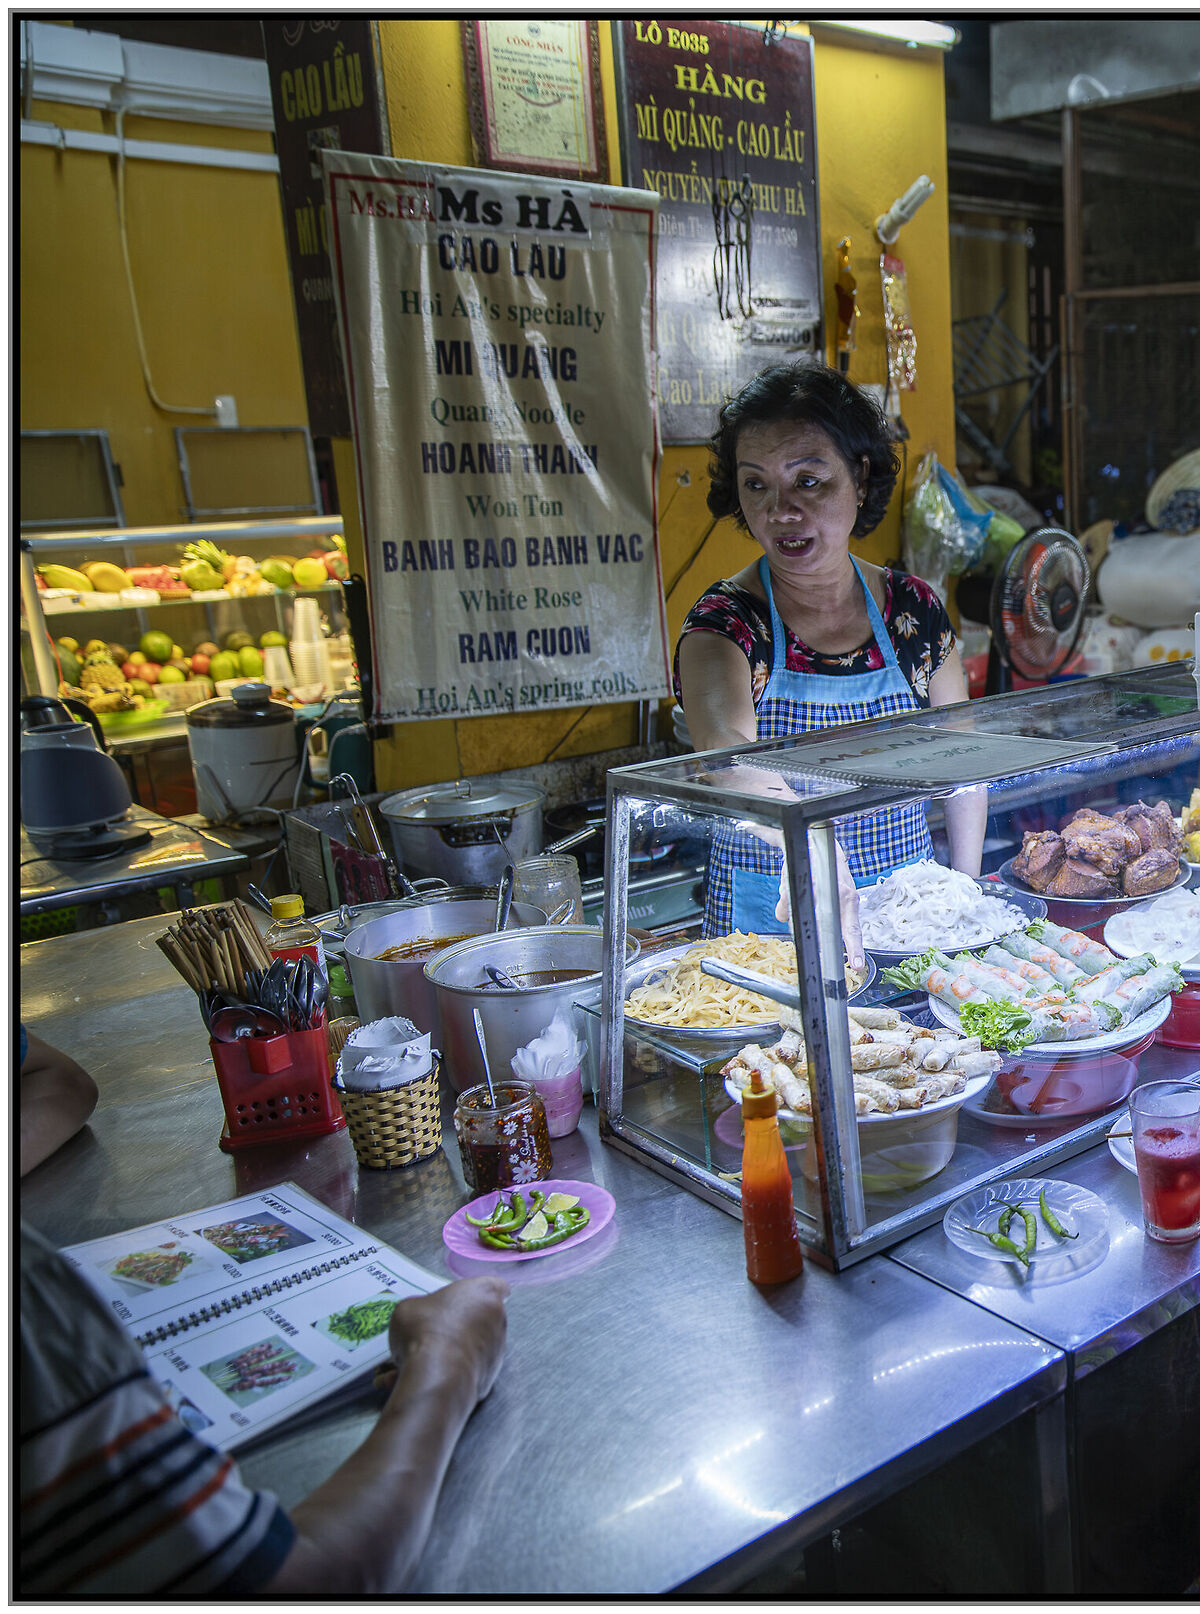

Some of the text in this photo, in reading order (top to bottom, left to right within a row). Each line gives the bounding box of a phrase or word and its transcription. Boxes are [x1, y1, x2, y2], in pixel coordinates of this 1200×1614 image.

[667, 27, 709, 55] E035
[280, 64, 321, 122] CAO
[673, 62, 768, 105] HÀNG
[635, 94, 660, 142] MÌ
[662, 96, 723, 152] QUẢNG
[737, 119, 770, 158] CAO
[772, 109, 805, 164] LẦU
[437, 186, 503, 226] Ms
[515, 190, 588, 233] HÀ
[750, 182, 781, 214] THU
[785, 180, 806, 216] HÀ
[295, 196, 319, 256] MÌ
[438, 233, 567, 280] CAO LAU
[400, 290, 606, 333] Hoi An's specialty
[434, 340, 473, 376] MI
[430, 398, 585, 429] Quan Noole
[421, 441, 599, 475] HOANH THANH
[465, 494, 564, 519] Won Ton
[383, 533, 645, 573] BANH BAO BANH VAC
[459, 586, 583, 613] White Rose
[458, 625, 592, 664] RAM CUON
[417, 671, 637, 712] Hoi An's spring rolls
